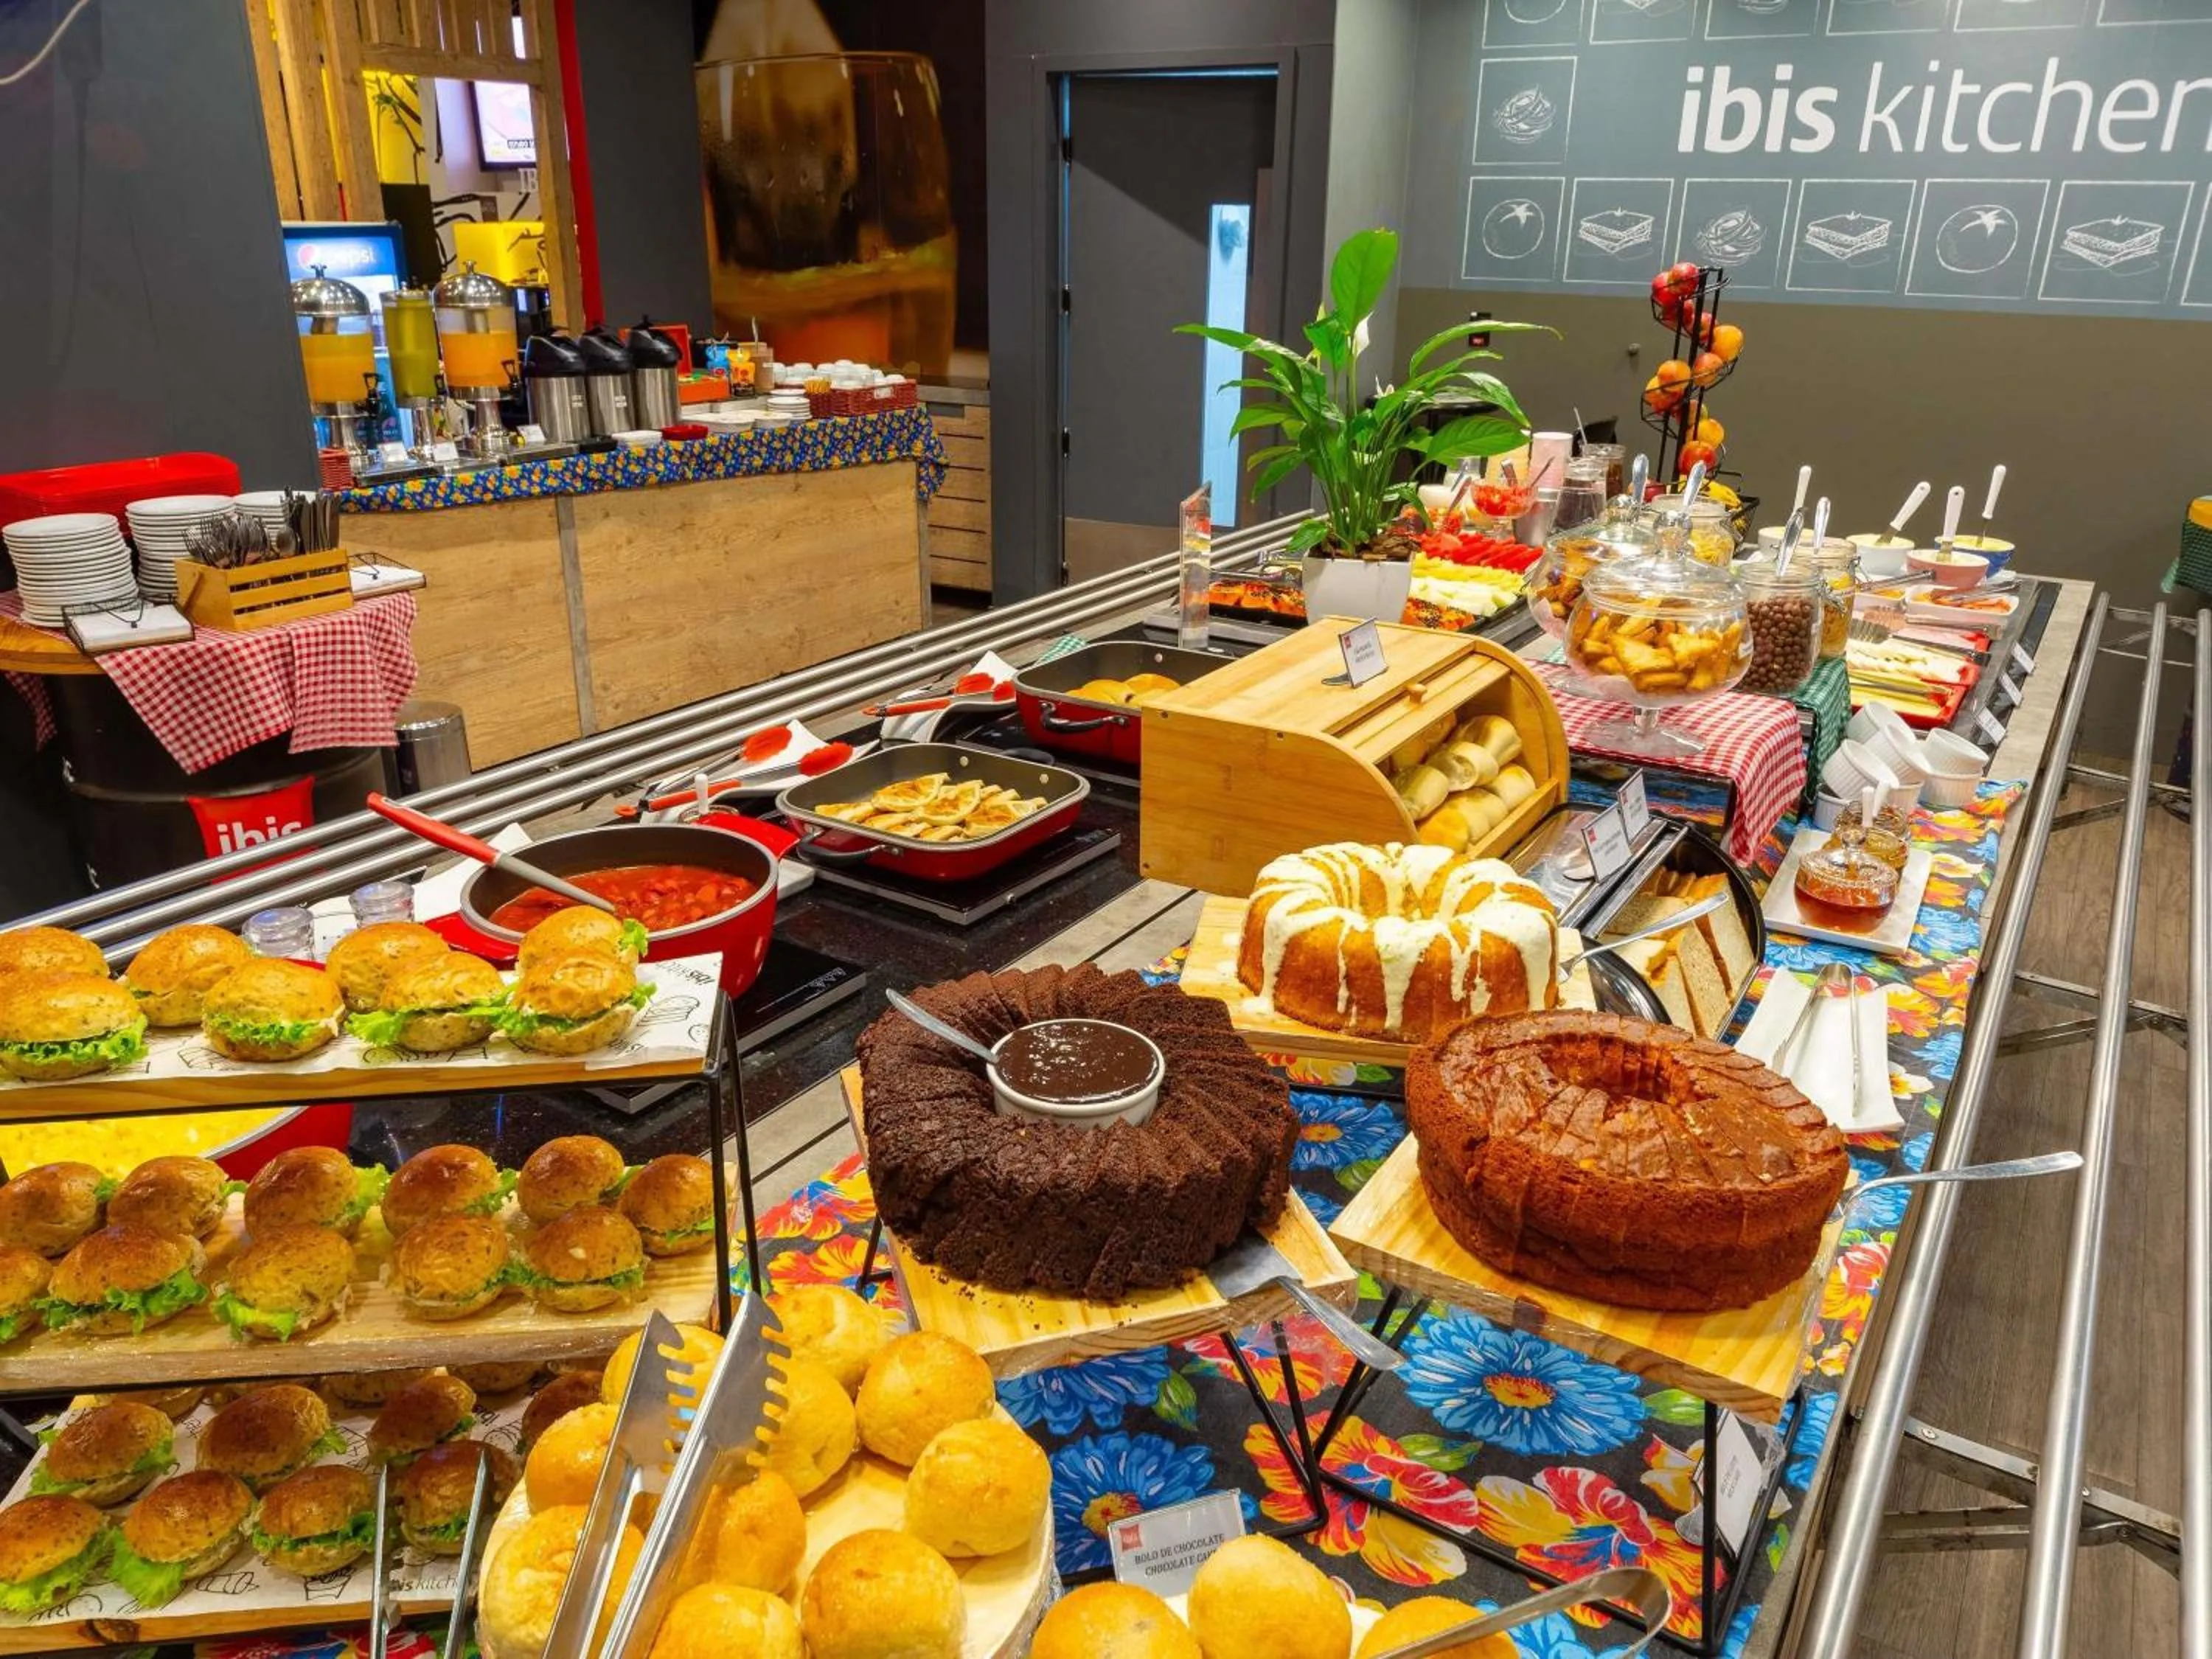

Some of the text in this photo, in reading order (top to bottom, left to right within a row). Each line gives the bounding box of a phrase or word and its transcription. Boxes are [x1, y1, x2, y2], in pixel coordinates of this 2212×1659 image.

[1677, 56, 2212, 154] ibis kitchen
[1134, 1533, 1225, 1565] BOLO DE CHOCOLATE
[1144, 1555, 1196, 1576] CHOCOLATE
